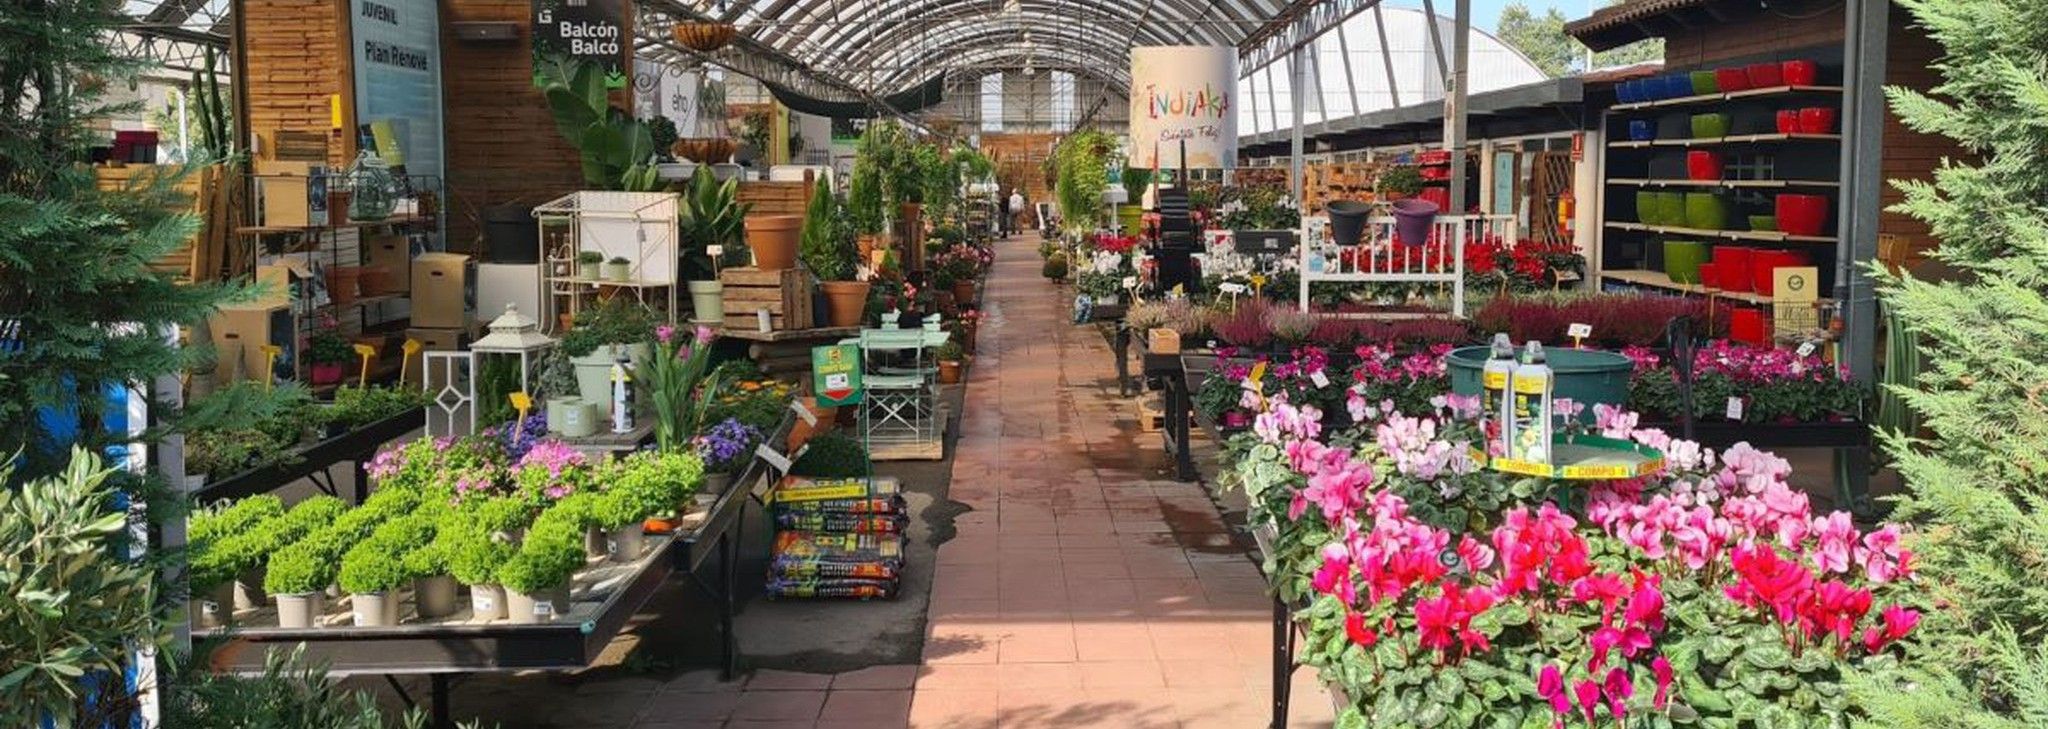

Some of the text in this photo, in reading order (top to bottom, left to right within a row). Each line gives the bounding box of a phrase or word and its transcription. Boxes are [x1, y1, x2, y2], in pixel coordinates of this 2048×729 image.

[361, 1, 398, 26] JUVENIL
[560, 20, 618, 37] Balcón
[364, 40, 390, 63] Plan
[571, 37, 618, 55] Balcó
